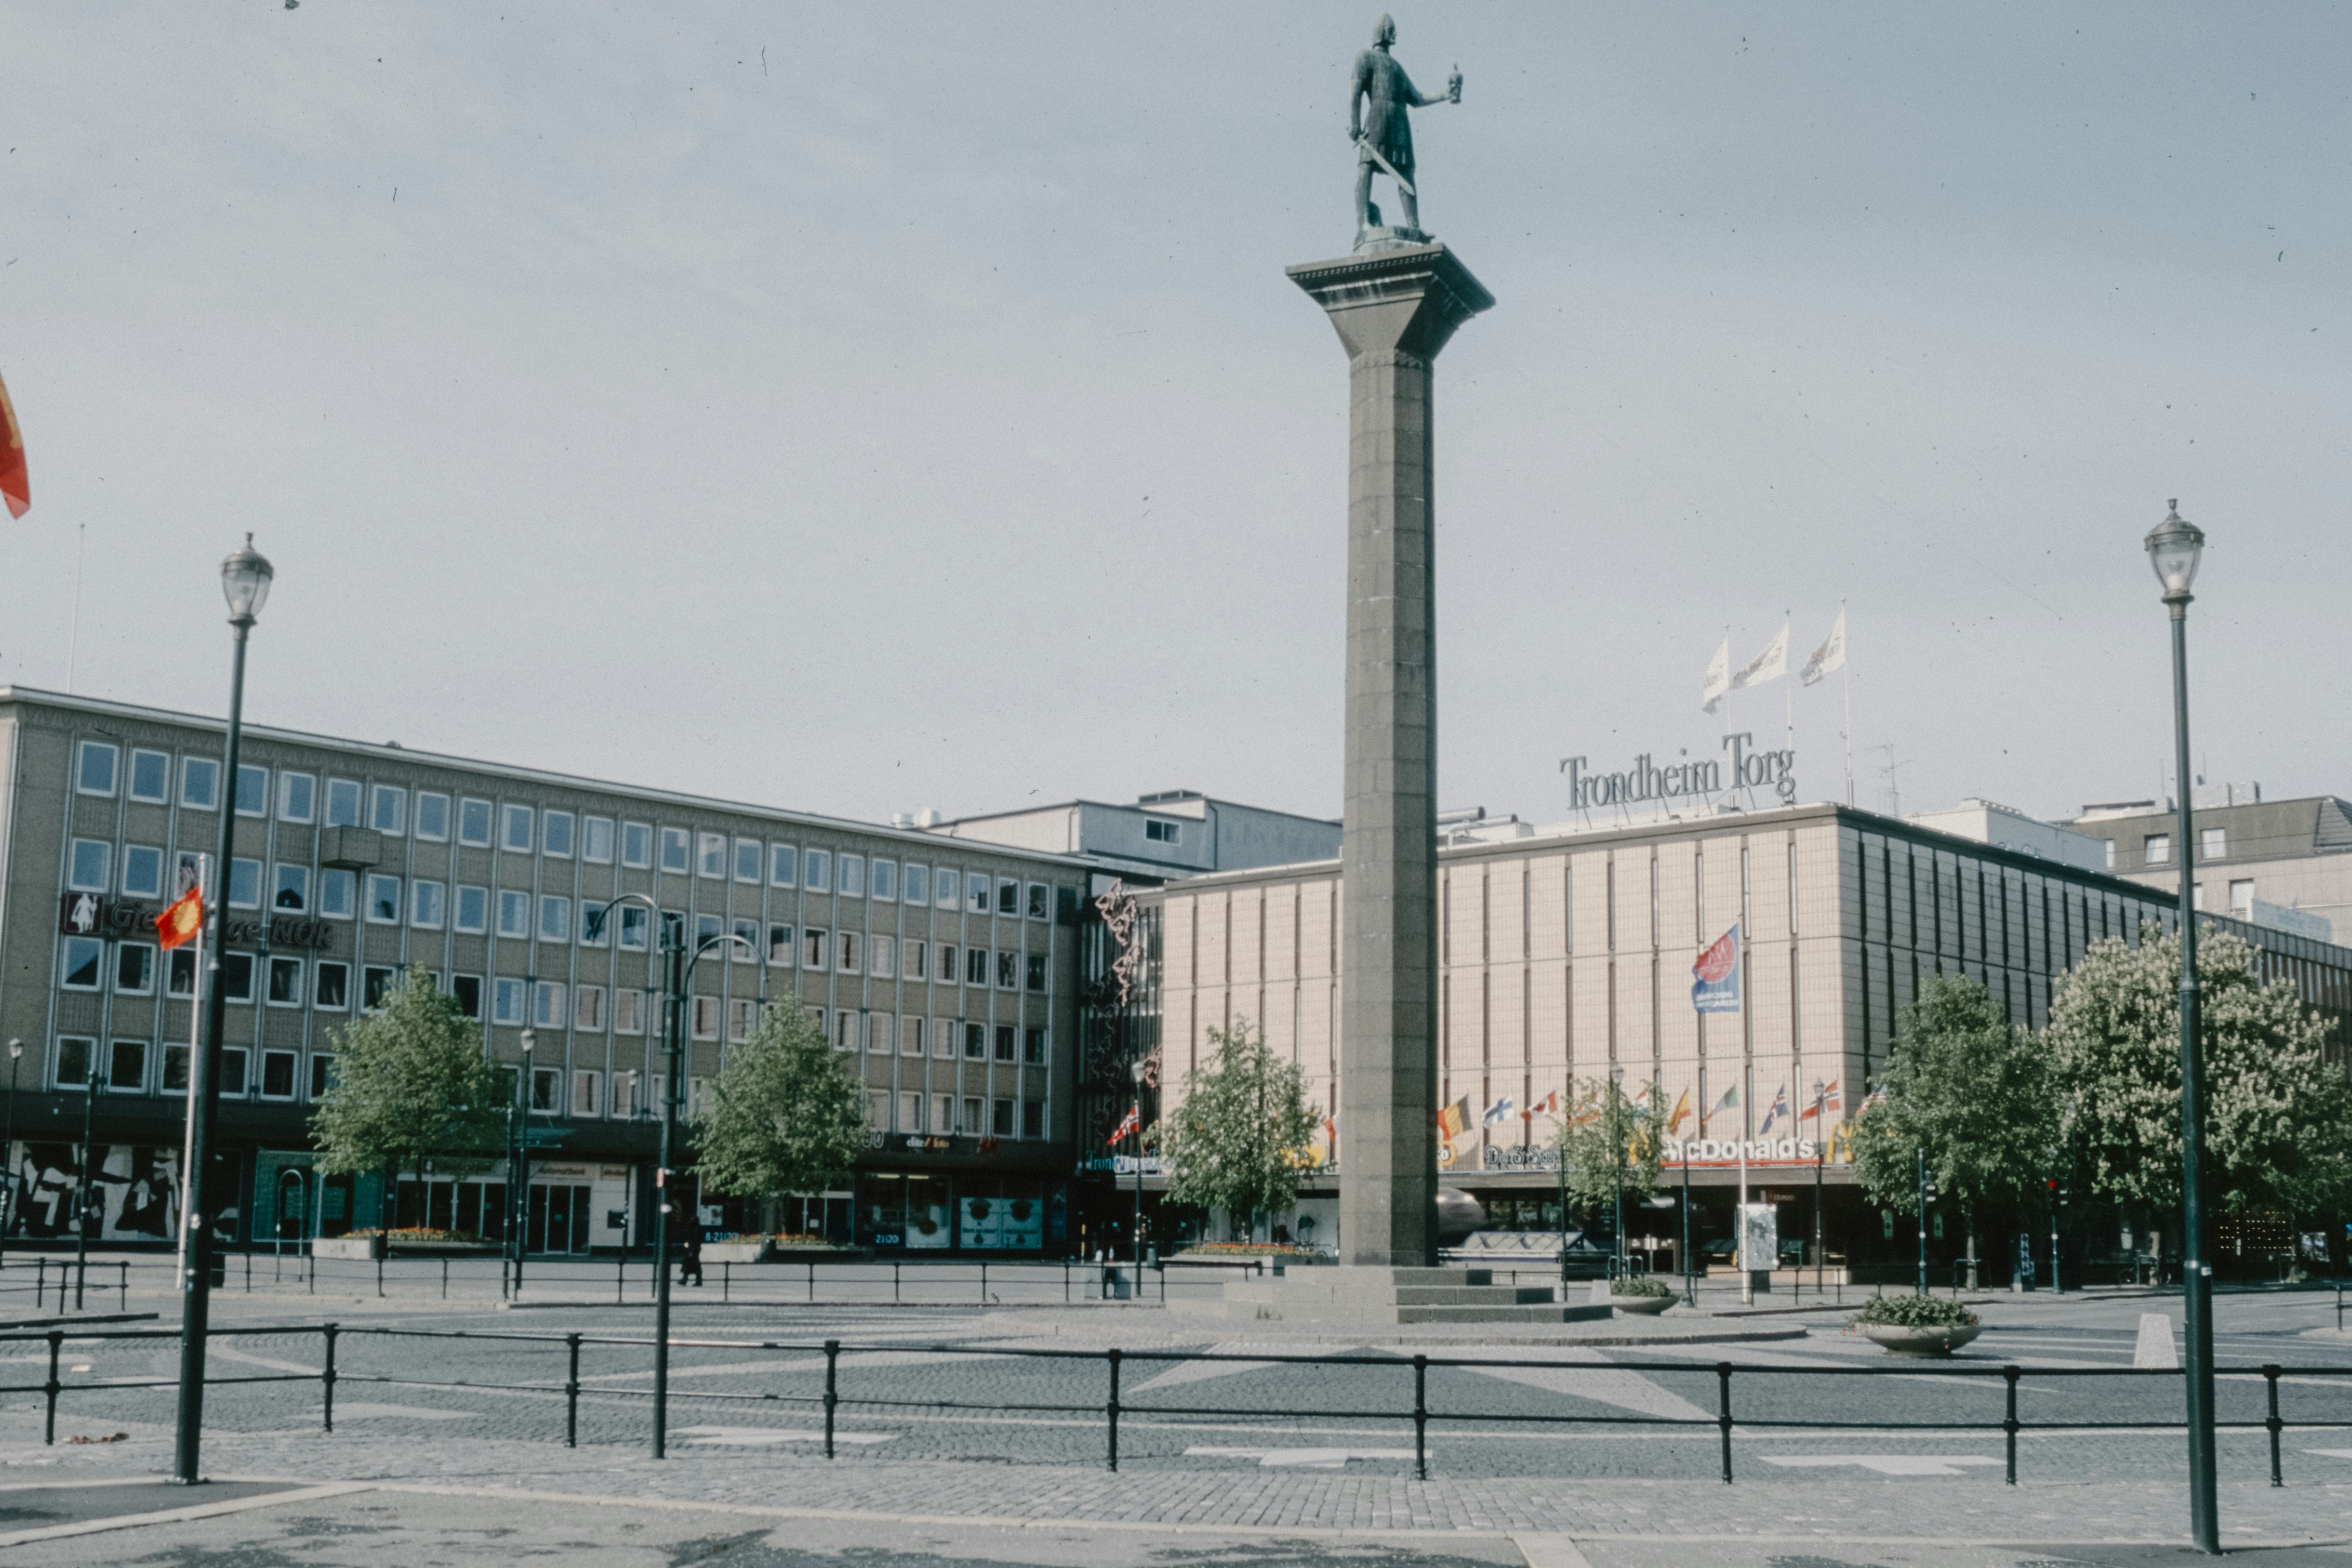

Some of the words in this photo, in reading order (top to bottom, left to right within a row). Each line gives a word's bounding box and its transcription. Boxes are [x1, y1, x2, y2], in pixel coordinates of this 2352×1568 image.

[1560, 748, 1721, 810] Trondheim
[1722, 732, 1795, 797] Torg
[268, 918, 334, 948] NOR
[1484, 1145, 1507, 1164] De
[1661, 1136, 1816, 1161] McDonald's
